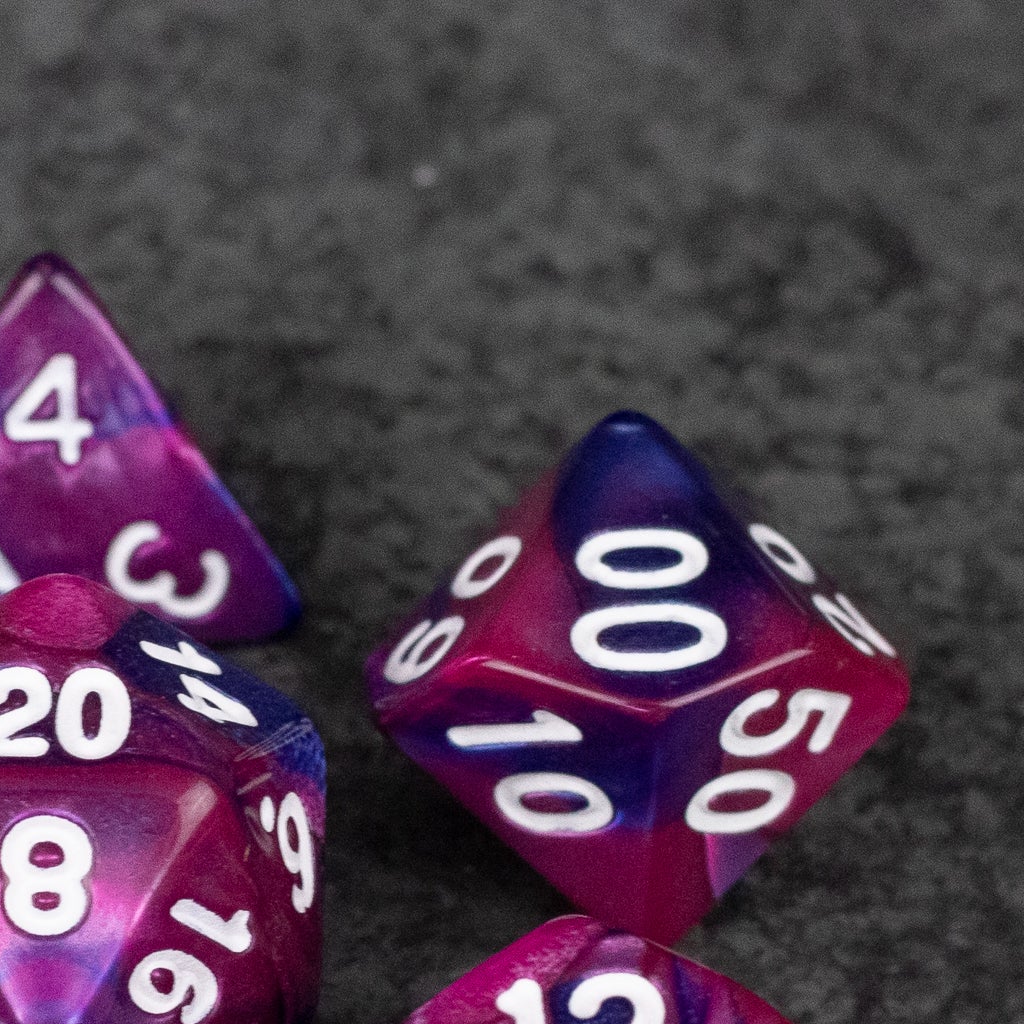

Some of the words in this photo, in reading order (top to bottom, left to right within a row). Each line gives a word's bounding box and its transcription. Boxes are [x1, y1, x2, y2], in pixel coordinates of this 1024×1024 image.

[3, 353, 93, 465] 4
[106, 522, 230, 619] 3
[138, 640, 259, 728] 14
[446, 709, 614, 834] 10
[685, 688, 852, 834] 50
[0, 814, 94, 937] 8
